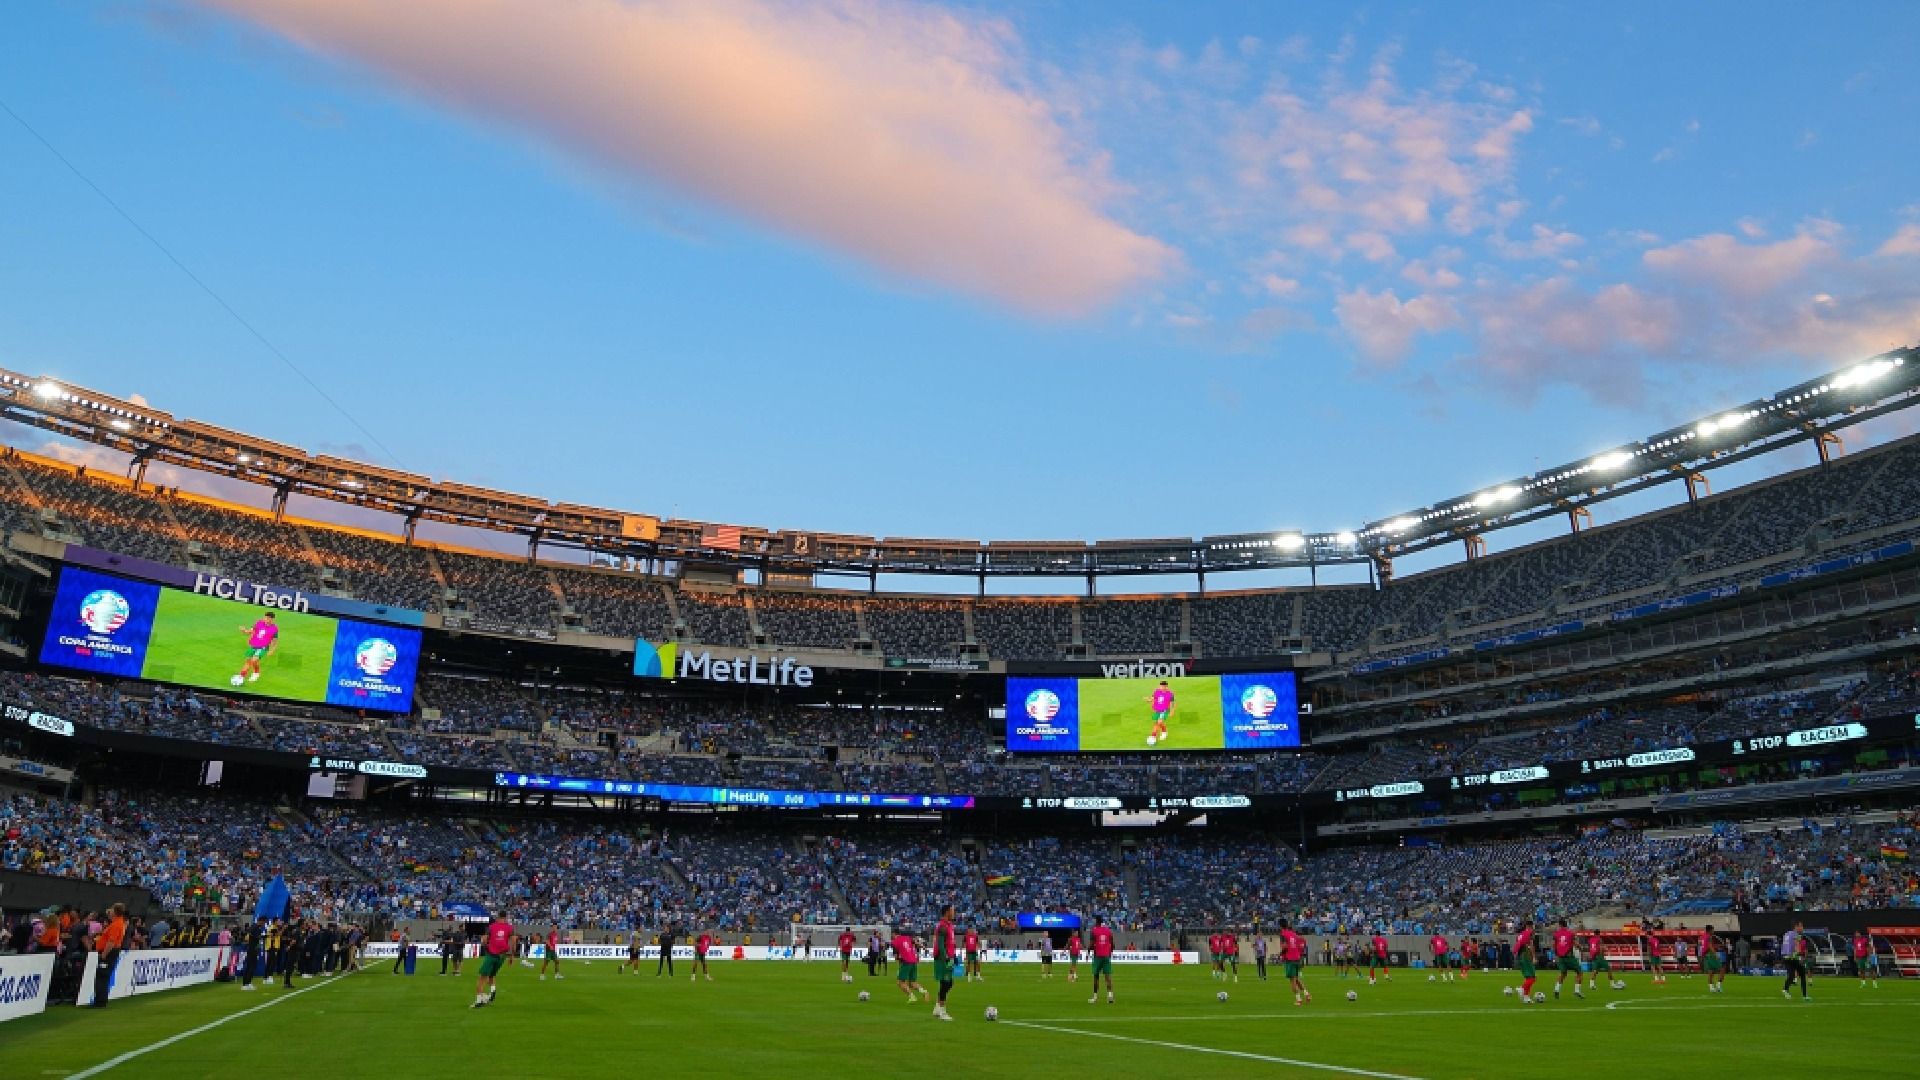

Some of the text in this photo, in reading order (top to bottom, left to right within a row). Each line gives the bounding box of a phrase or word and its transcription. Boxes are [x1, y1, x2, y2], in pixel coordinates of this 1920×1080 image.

[194, 573, 309, 613] HCLTech
[680, 650, 814, 687] MetLife
[1101, 659, 1185, 679] verizon
[1750, 726, 1850, 750] STOP RACISM
[325, 760, 356, 770] BASTA
[1594, 758, 1624, 770] BASTA
[1464, 767, 1536, 786] STOP RACISM
[729, 789, 770, 803] MetLife
[1037, 798, 1110, 808] STOP RACISM
[559, 947, 613, 958] INGRESSOS
